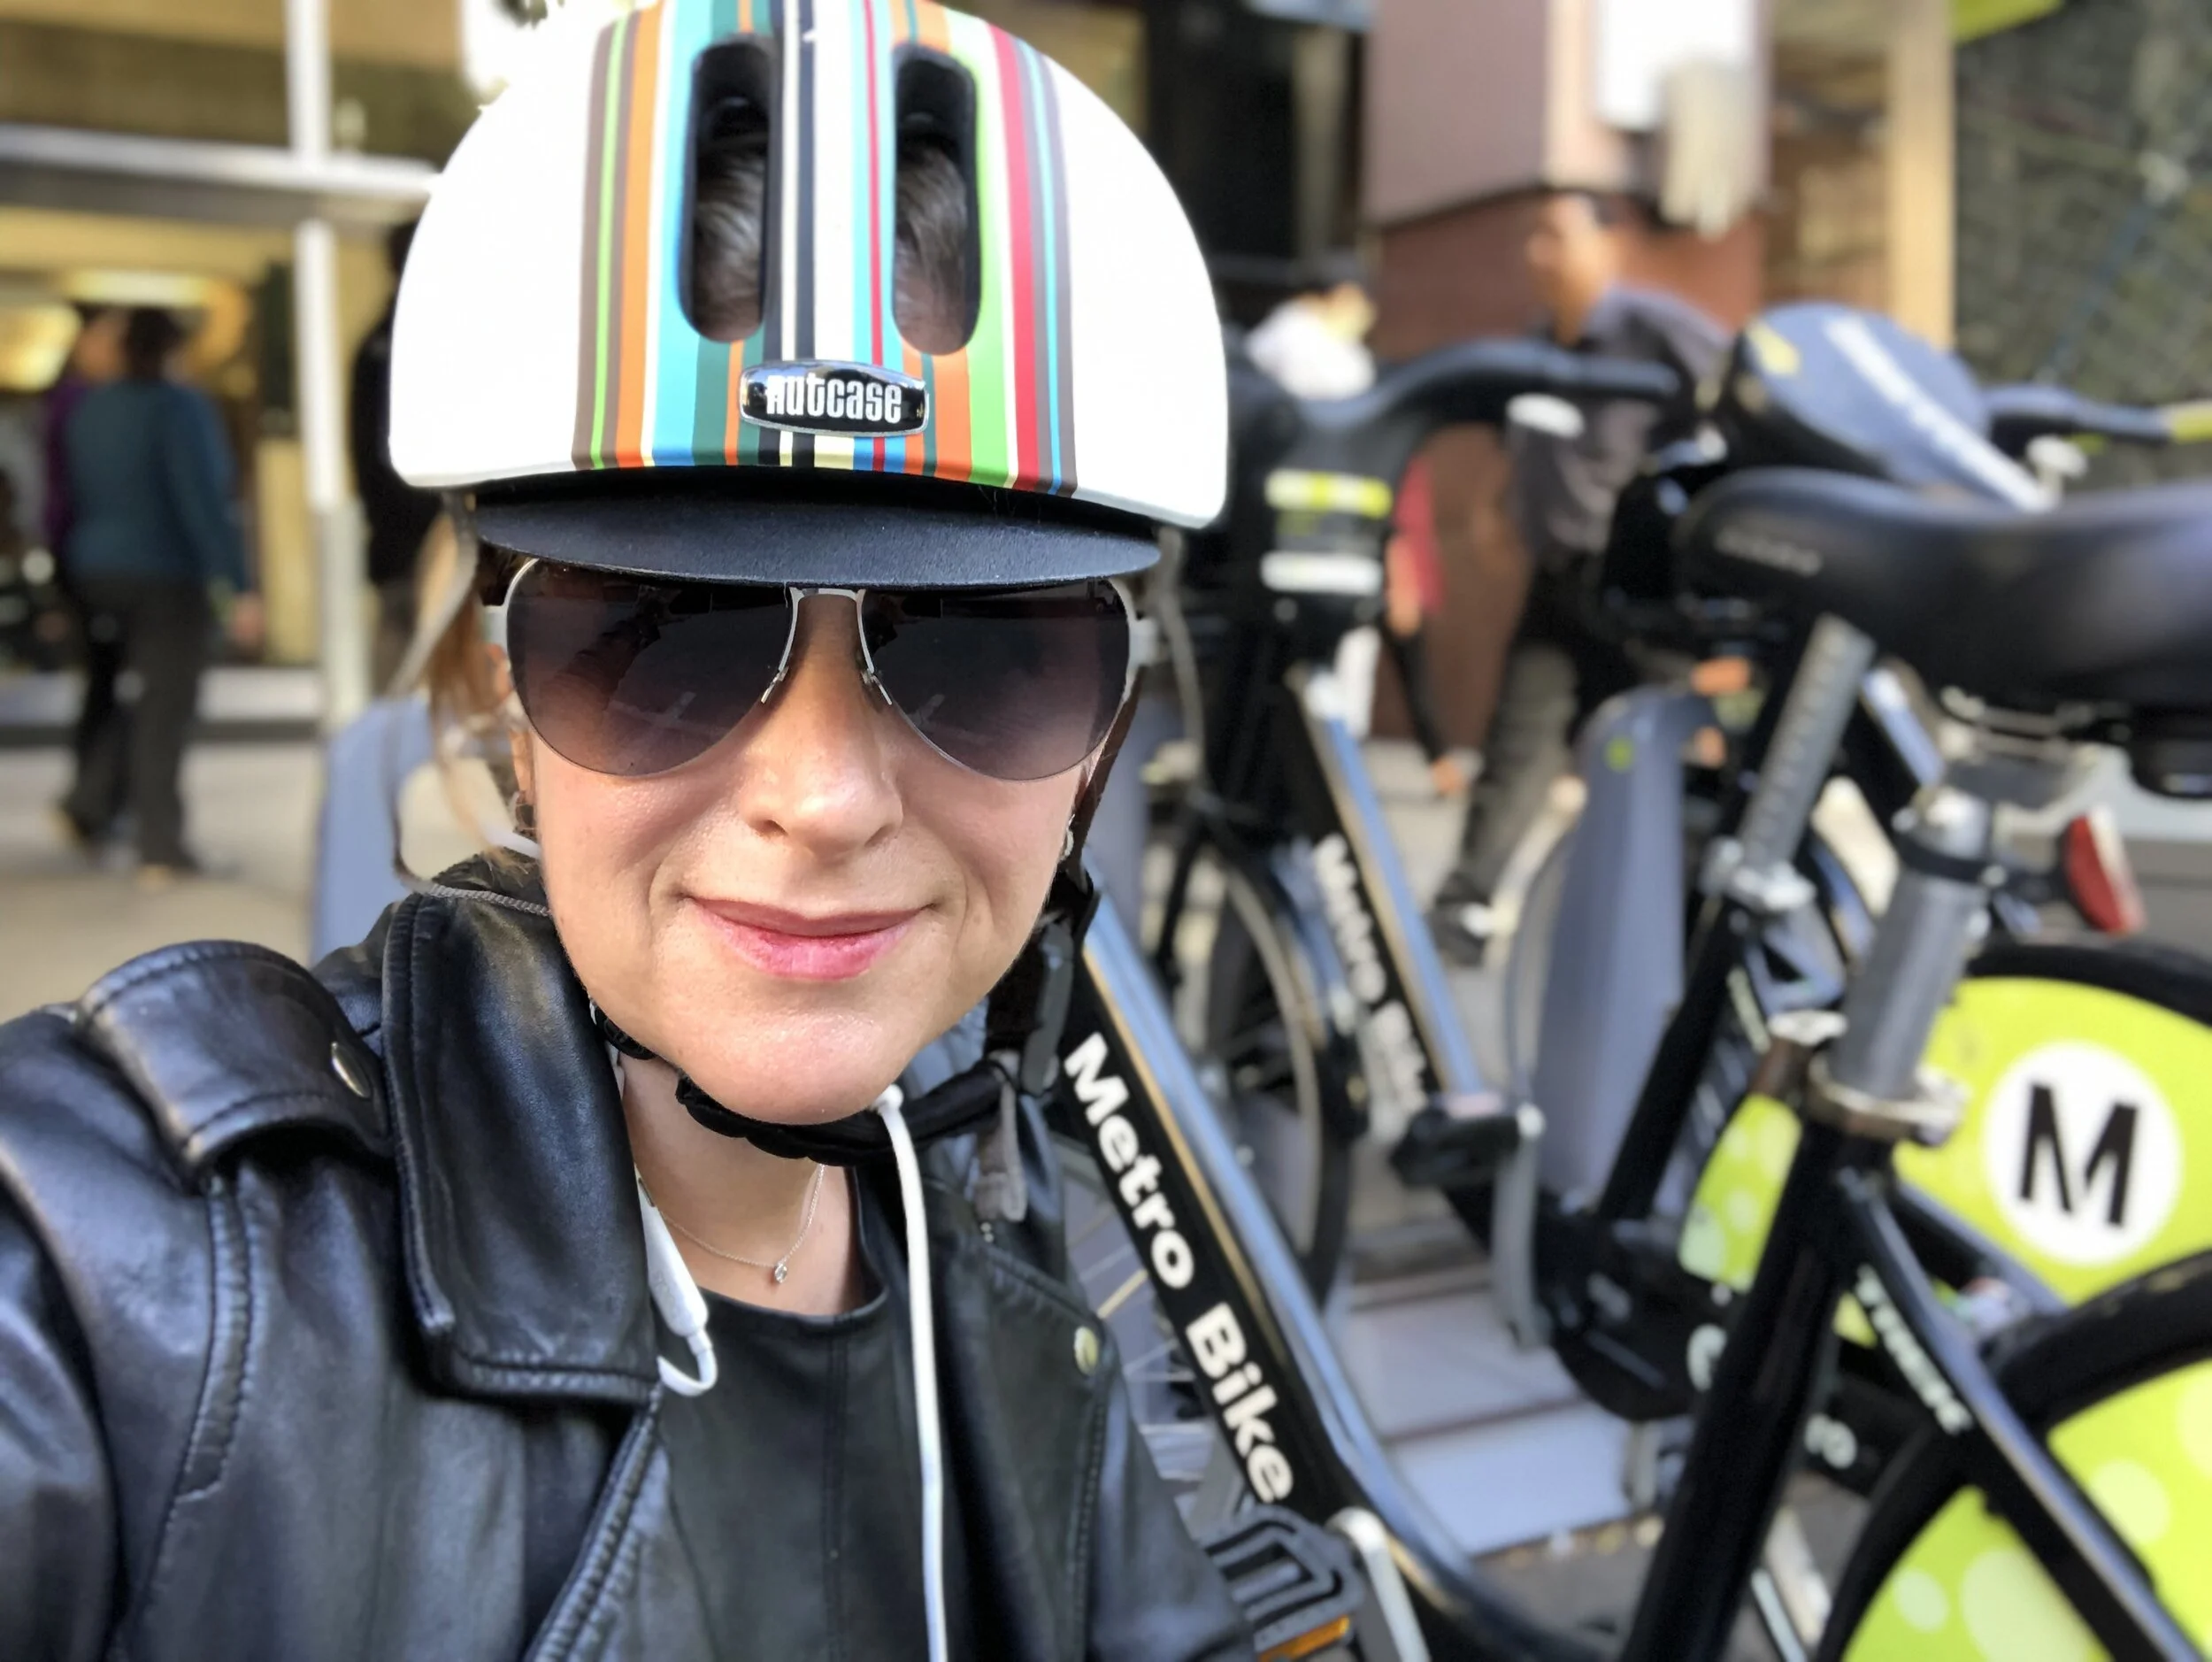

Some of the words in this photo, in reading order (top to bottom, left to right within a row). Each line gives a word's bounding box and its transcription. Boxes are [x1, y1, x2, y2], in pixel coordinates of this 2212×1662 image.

[1064, 1031, 1194, 1289] Metro
[1186, 1302, 1294, 1504] Bike
[2019, 1081, 2139, 1230] M
